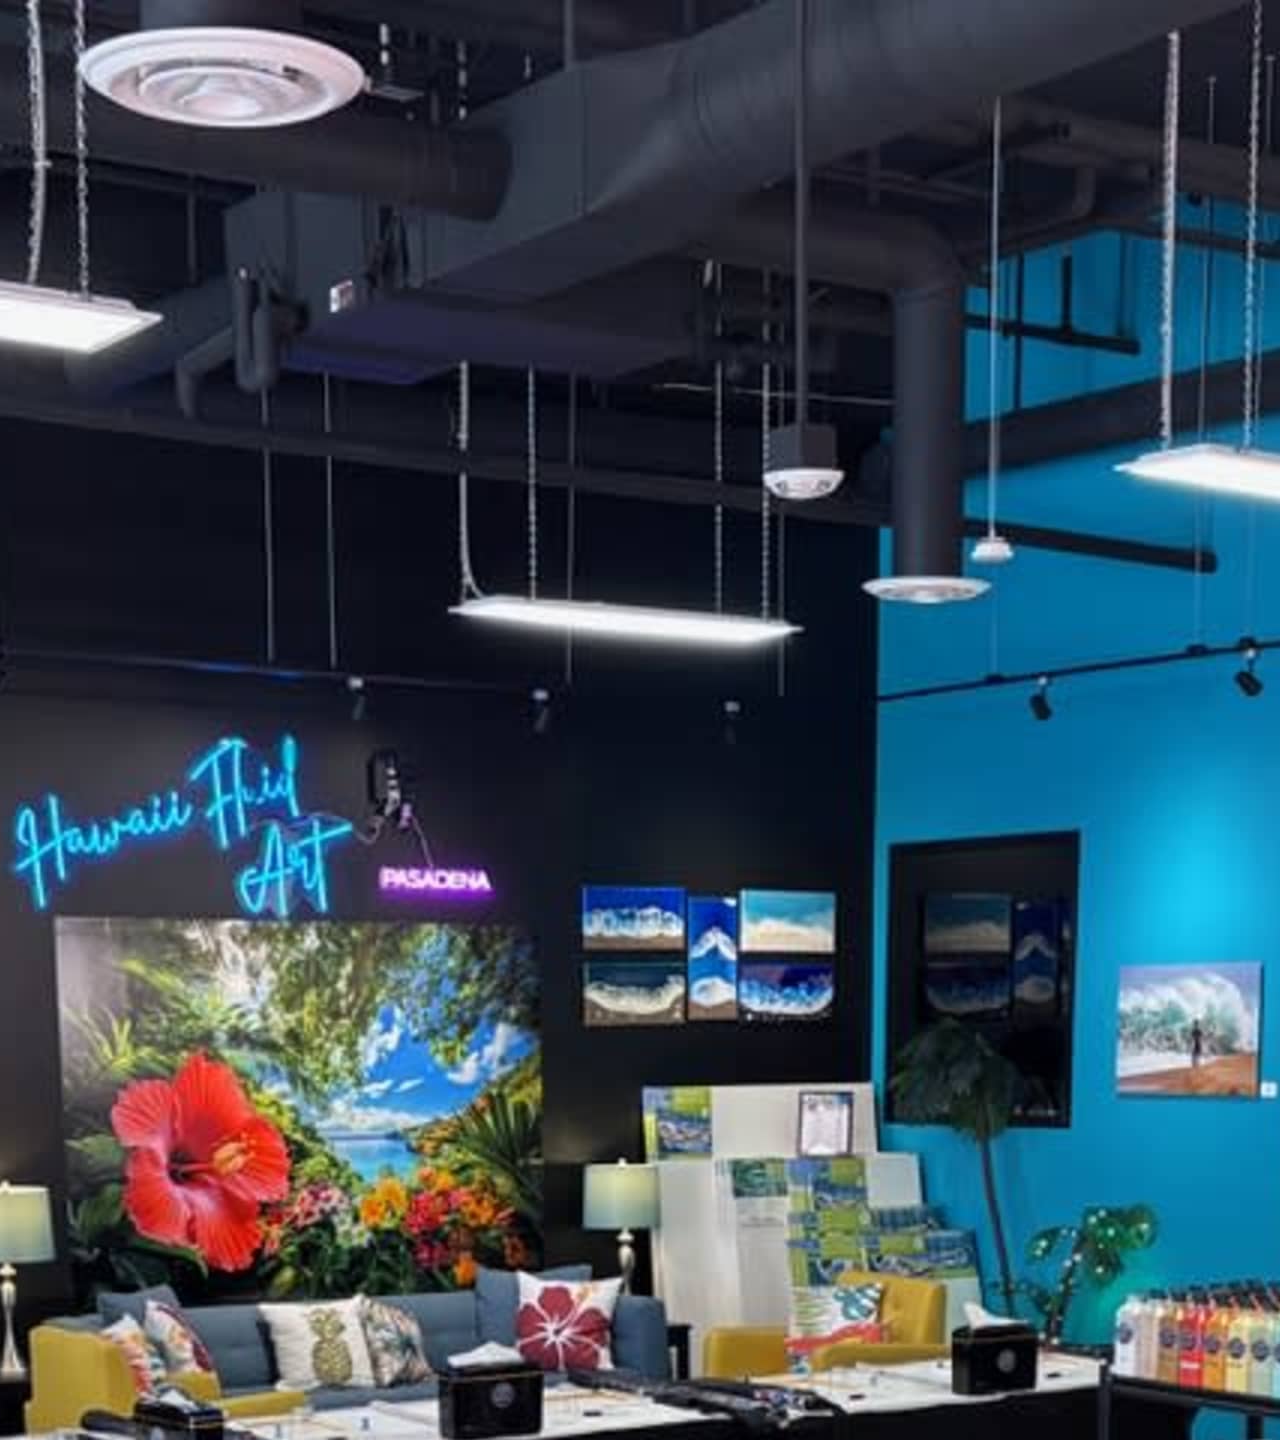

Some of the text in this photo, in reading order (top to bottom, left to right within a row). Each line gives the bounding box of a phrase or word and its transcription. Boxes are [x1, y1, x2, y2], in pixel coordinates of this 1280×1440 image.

[14, 738, 300, 908] Hawaii Fluid
[240, 818, 352, 915] Art
[380, 866, 491, 892] PASADENA
